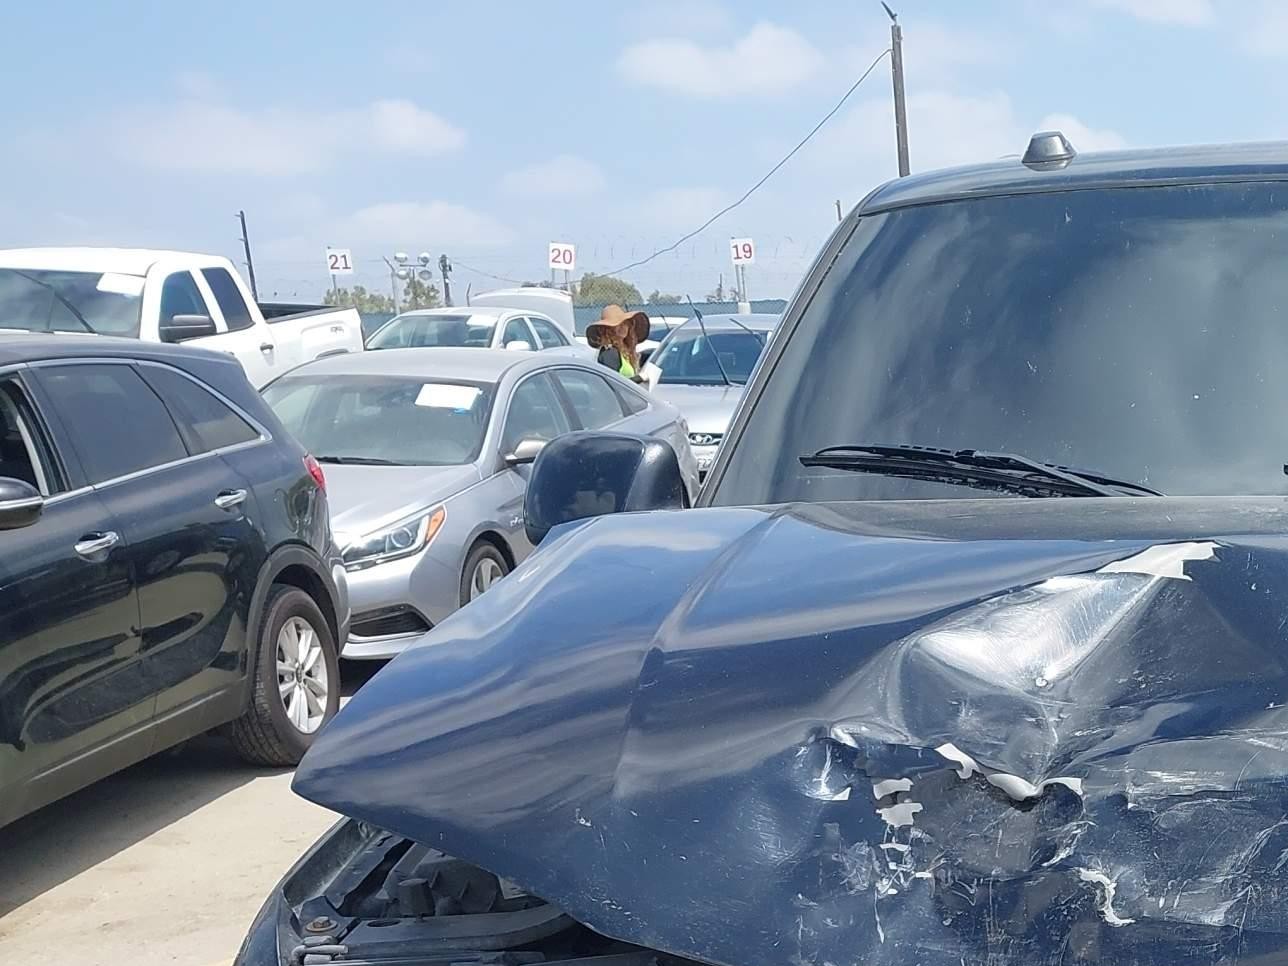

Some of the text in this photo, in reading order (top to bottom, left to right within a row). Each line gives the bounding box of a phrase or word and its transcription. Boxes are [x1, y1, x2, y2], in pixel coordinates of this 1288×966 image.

[551, 247, 573, 264] 20
[731, 242, 753, 260] 19
[328, 253, 352, 270] 21
